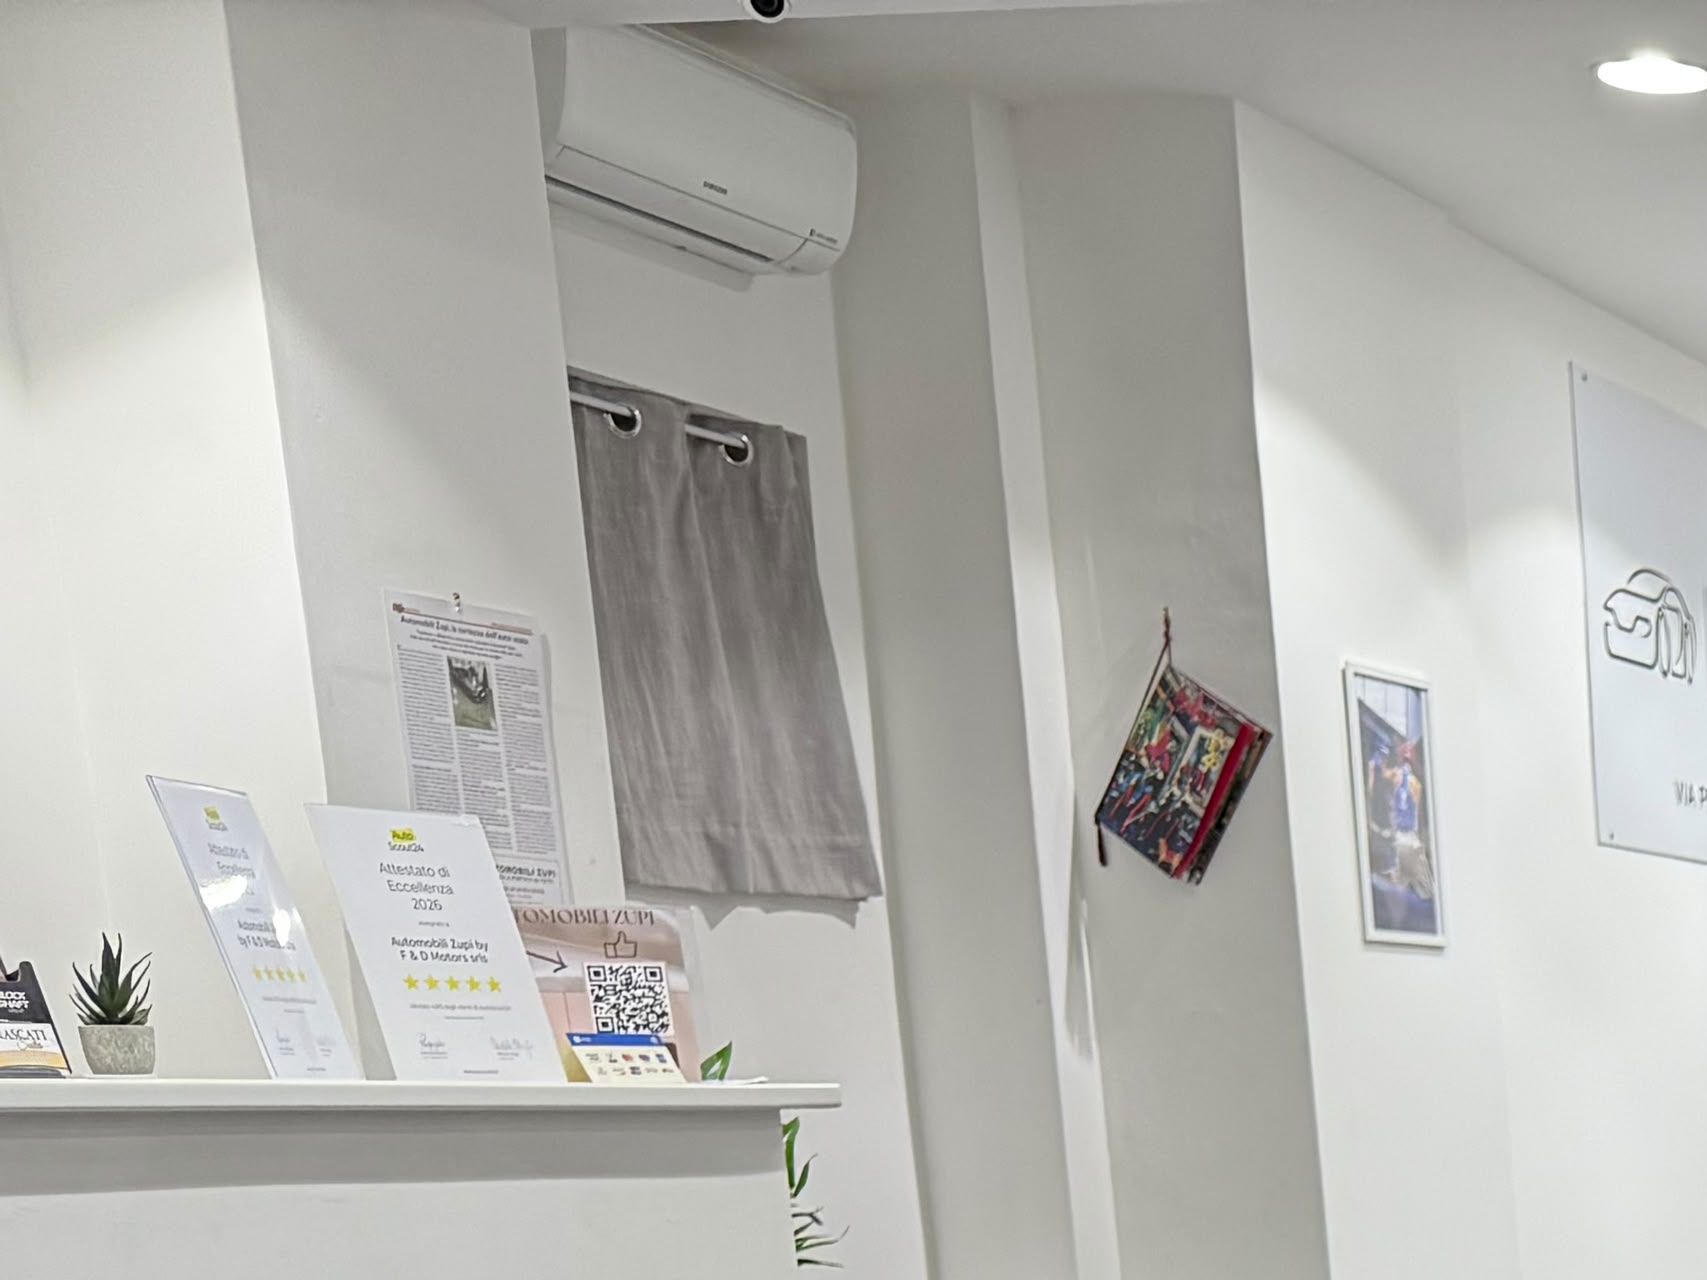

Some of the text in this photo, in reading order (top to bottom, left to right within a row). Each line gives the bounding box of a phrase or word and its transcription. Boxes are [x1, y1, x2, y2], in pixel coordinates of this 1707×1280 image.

[1673, 779, 1695, 806] VIA
[379, 862, 451, 878] Attestato di
[386, 879, 454, 895] Eccellenza
[412, 898, 443, 911] 2026
[515, 908, 655, 926] TOMOBILI ZUPI
[391, 937, 488, 952] Automobili Zupi by
[400, 950, 405, 960] F
[420, 951, 429, 961] D
[431, 951, 468, 962] Motors
